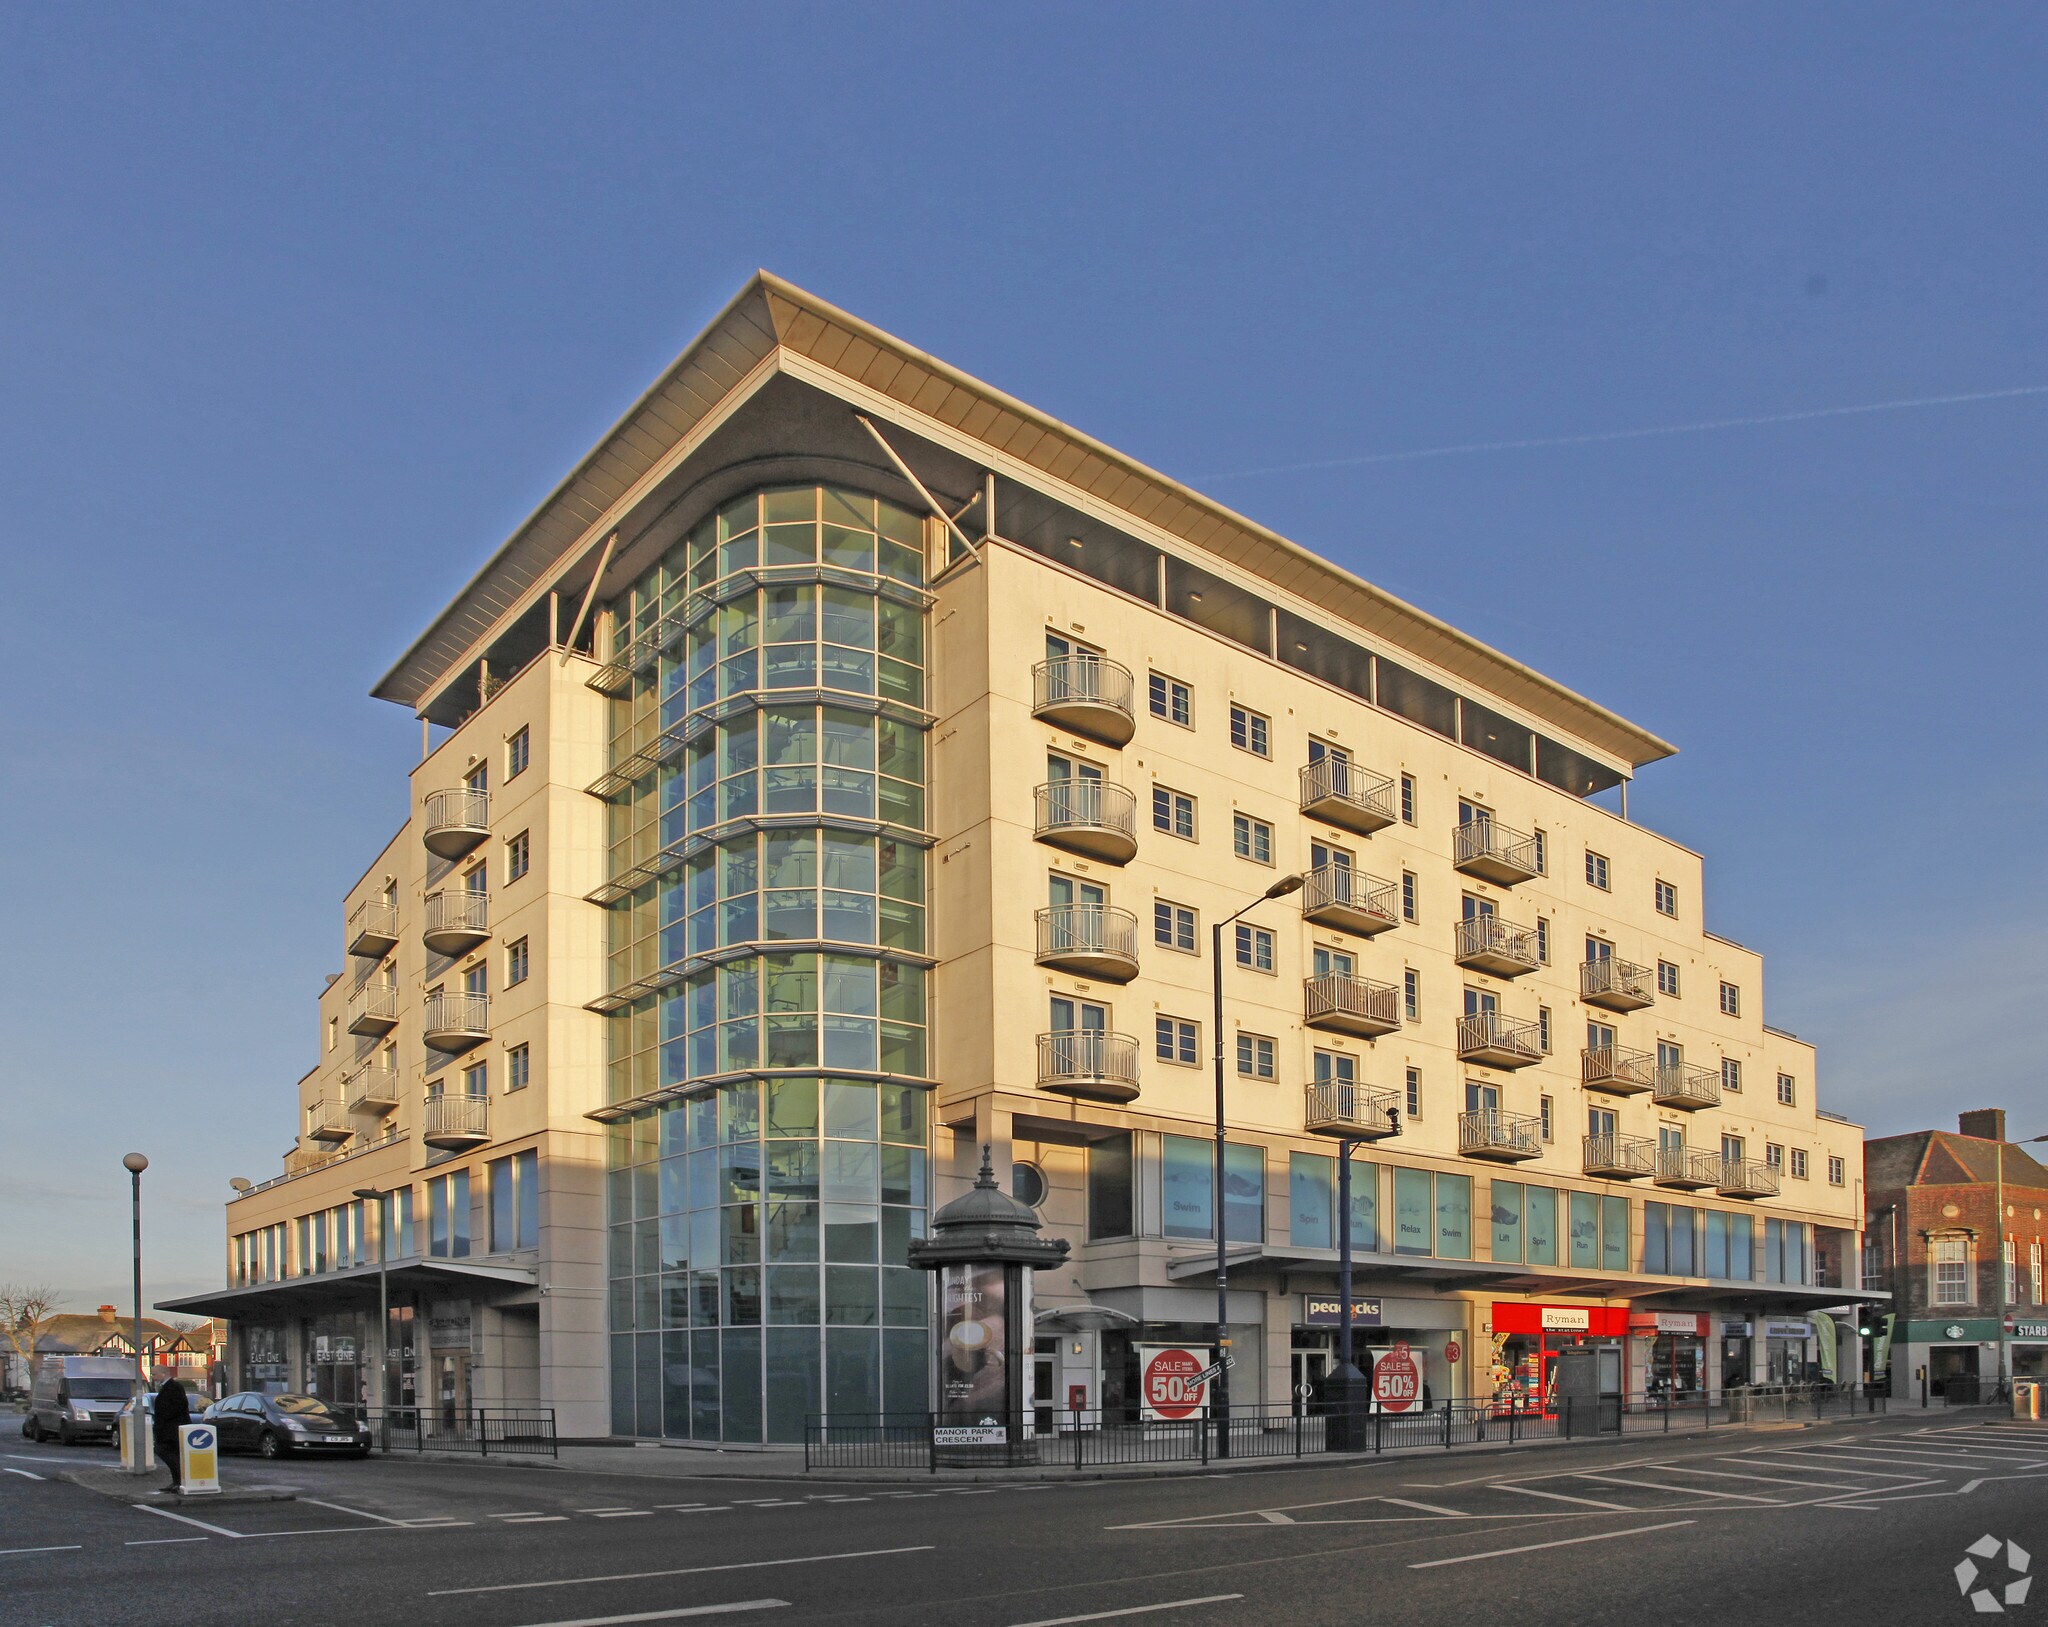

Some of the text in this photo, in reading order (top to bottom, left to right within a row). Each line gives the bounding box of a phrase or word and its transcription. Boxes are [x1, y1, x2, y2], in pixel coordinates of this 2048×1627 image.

[1173, 1201, 1201, 1213] Swim
[1299, 1214, 1319, 1225] Spin
[1400, 1223, 1421, 1234] Relax
[1441, 1228, 1462, 1238] Swim
[1498, 1233, 1510, 1242] Lift
[1532, 1237, 1547, 1246] Spin
[1576, 1241, 1589, 1249] Run
[1605, 1244, 1621, 1252] Relax
[1309, 1302, 1380, 1317] peaocks
[1546, 1314, 1585, 1324] Ryman
[1661, 1318, 1694, 1328] Ryman
[251, 1351, 280, 1363] EAST ONE
[316, 1351, 335, 1362] EAST
[1154, 1361, 1181, 1372] SALE
[1380, 1361, 1401, 1371] SALE
[1378, 1375, 1414, 1398] 50%
[1183, 1393, 1198, 1401] OFF
[1402, 1389, 1414, 1397] OFF
